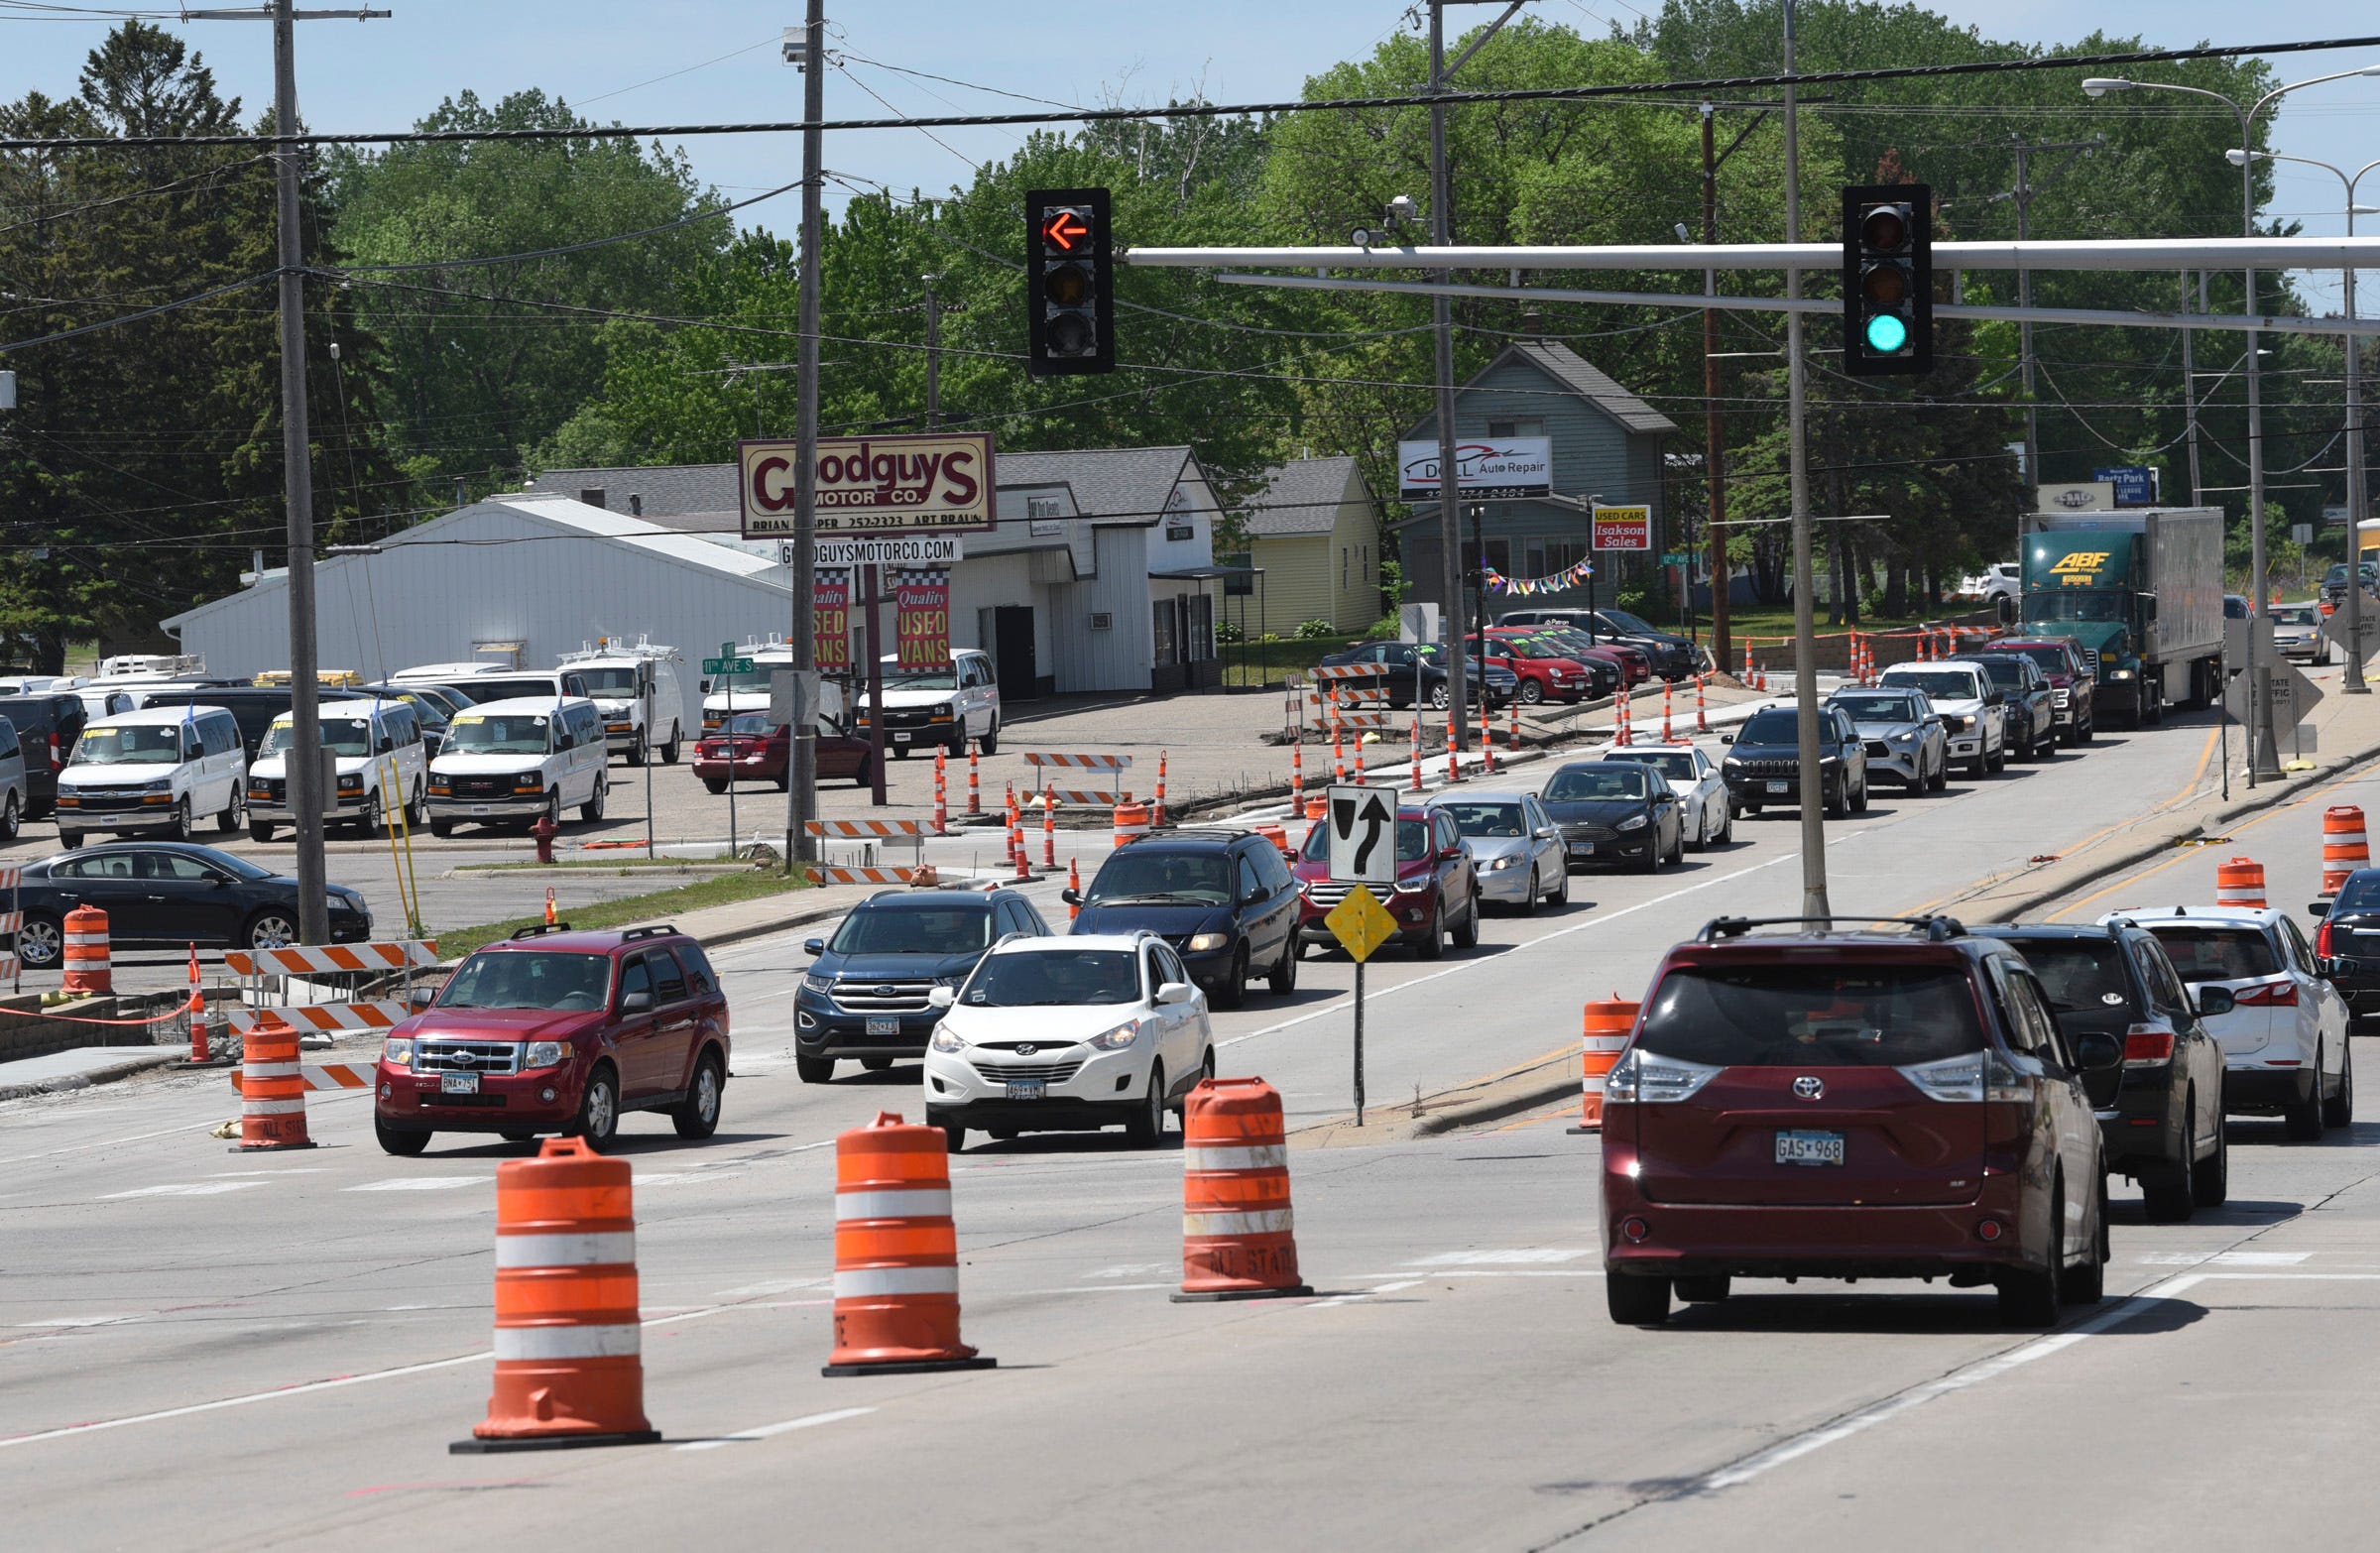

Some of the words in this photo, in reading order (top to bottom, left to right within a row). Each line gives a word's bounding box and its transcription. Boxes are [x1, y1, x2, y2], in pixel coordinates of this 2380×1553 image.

[1508, 462, 1545, 476] Repair
[2123, 473, 2144, 483] Park
[891, 489, 922, 504] CO.
[913, 515, 939, 527] ART
[1596, 512, 1619, 521] USED
[1621, 511, 1646, 521] CARS
[1597, 524, 1645, 536] Isakson
[1604, 536, 1637, 547] Sales
[782, 540, 954, 563] GGUYSMOTORCO.COM
[2054, 551, 2112, 568] ABF
[814, 590, 846, 607] uality
[898, 590, 945, 608] Quality
[813, 610, 844, 635] SED
[899, 611, 946, 636] USED
[814, 639, 844, 663] ANS
[899, 639, 948, 663] VANS
[722, 659, 741, 672] AVE
[746, 659, 753, 671] S
[1778, 1138, 1805, 1157] GAS
[1815, 1139, 1842, 1158] 968
